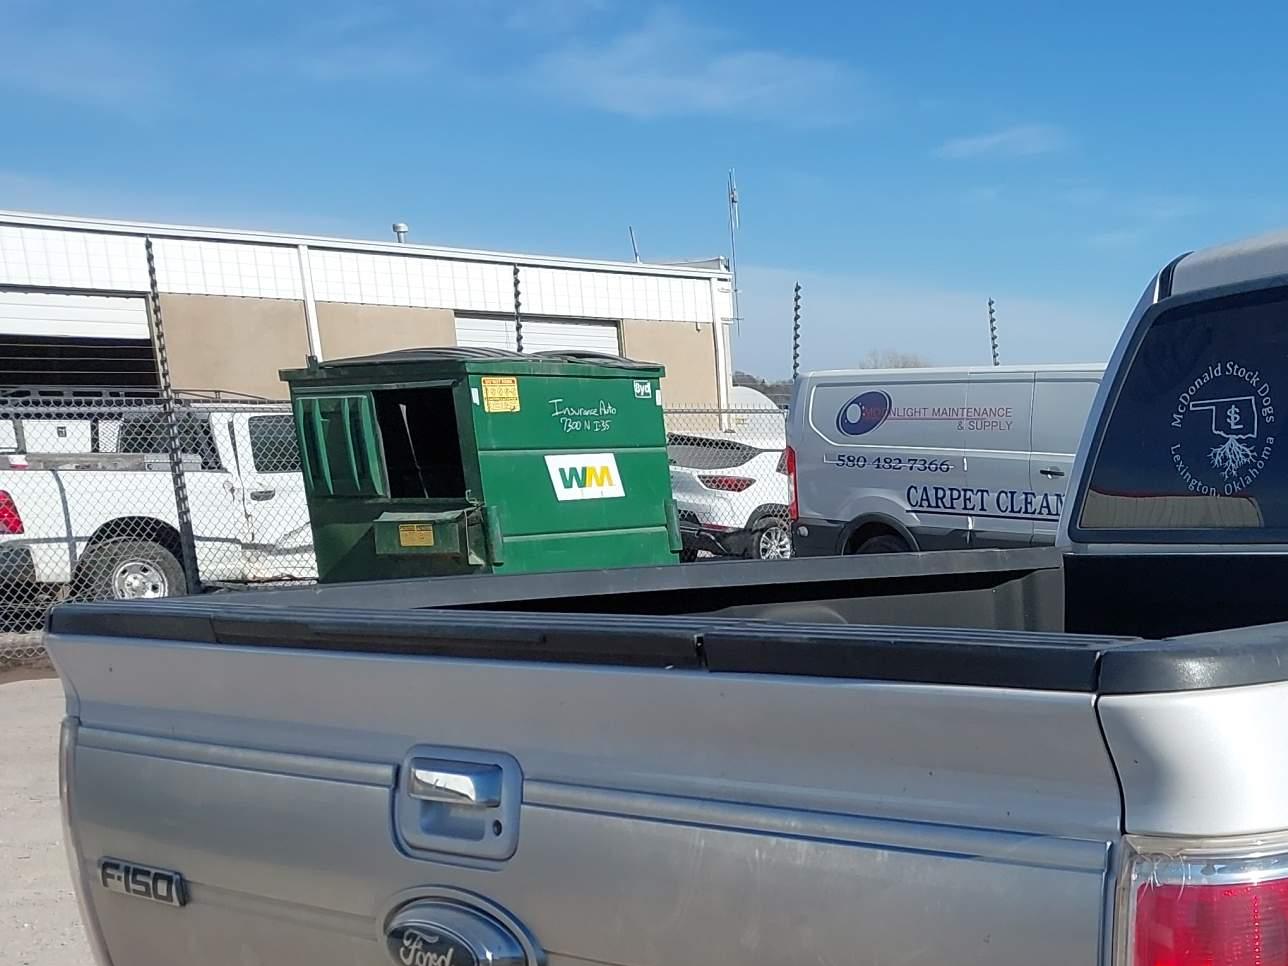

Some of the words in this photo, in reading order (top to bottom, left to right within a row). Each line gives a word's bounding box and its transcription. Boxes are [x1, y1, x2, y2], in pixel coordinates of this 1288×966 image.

[1171, 362, 1222, 429] McDonald
[1226, 361, 1260, 387] Stock
[1257, 383, 1276, 424] Dogs
[548, 399, 599, 417] Insurance
[600, 400, 617, 415] Auto
[932, 408, 1012, 418] MAINTENANCE
[584, 420, 591, 431] N
[957, 421, 964, 430] &
[968, 421, 1012, 431] SUPPLY
[837, 454, 867, 469] 580
[873, 457, 902, 471] 482
[907, 459, 950, 473] 7366
[1224, 436, 1275, 496] Oklahoma
[558, 465, 614, 489] WM
[906, 485, 990, 512] CARPET
[101, 861, 174, 902] F-150
